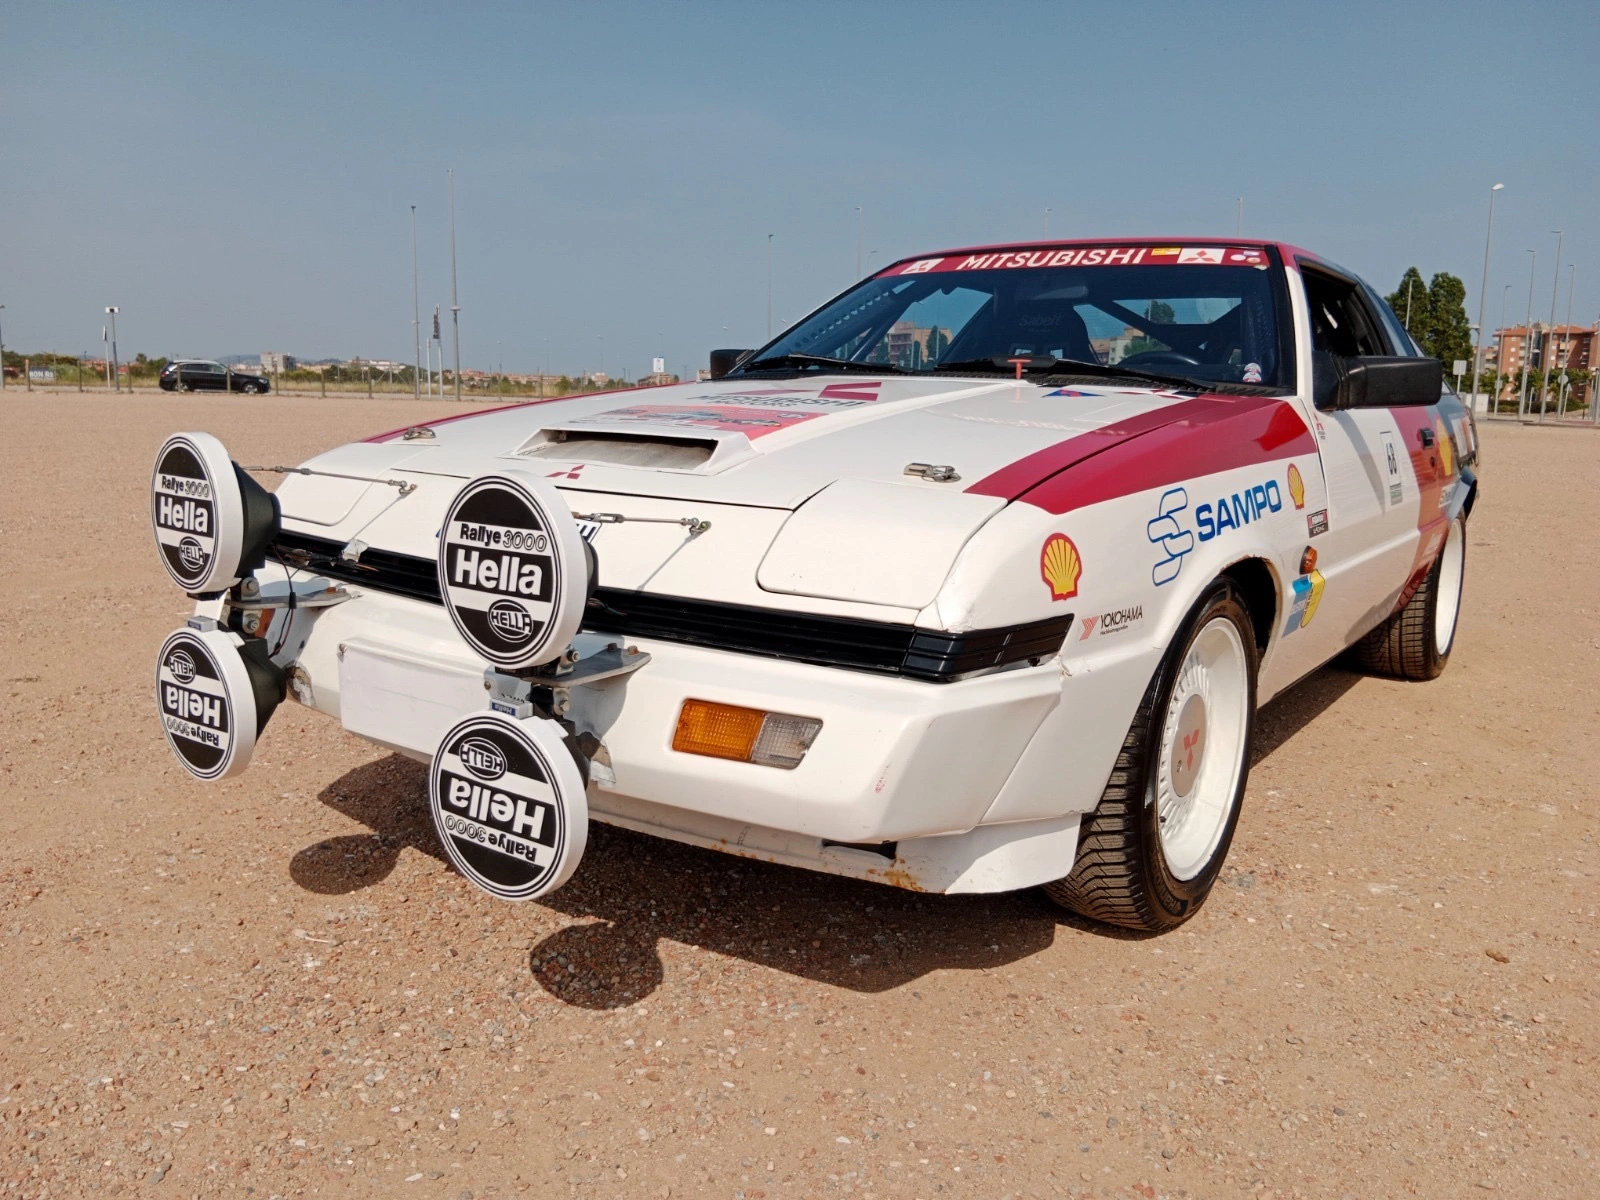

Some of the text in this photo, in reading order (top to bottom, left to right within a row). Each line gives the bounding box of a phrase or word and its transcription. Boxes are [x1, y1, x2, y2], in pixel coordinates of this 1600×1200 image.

[956, 248, 1148, 270] MITSUBISHI
[161, 475, 210, 498] Rallye 3000
[160, 496, 209, 533] Hella
[1195, 479, 1282, 542] SAMPO
[460, 523, 547, 552] Rallye 3000
[180, 544, 205, 565] HELLA
[455, 548, 543, 596] Hella
[490, 609, 532, 635] HELLA
[1100, 604, 1143, 629] YOKOHAMA
[169, 655, 195, 676] HELLA
[166, 685, 221, 727] Hella
[166, 717, 219, 747] Rallye 3000
[461, 743, 503, 772] HELLA
[449, 777, 546, 839] Hella
[445, 815, 538, 862] Rallye 3000
